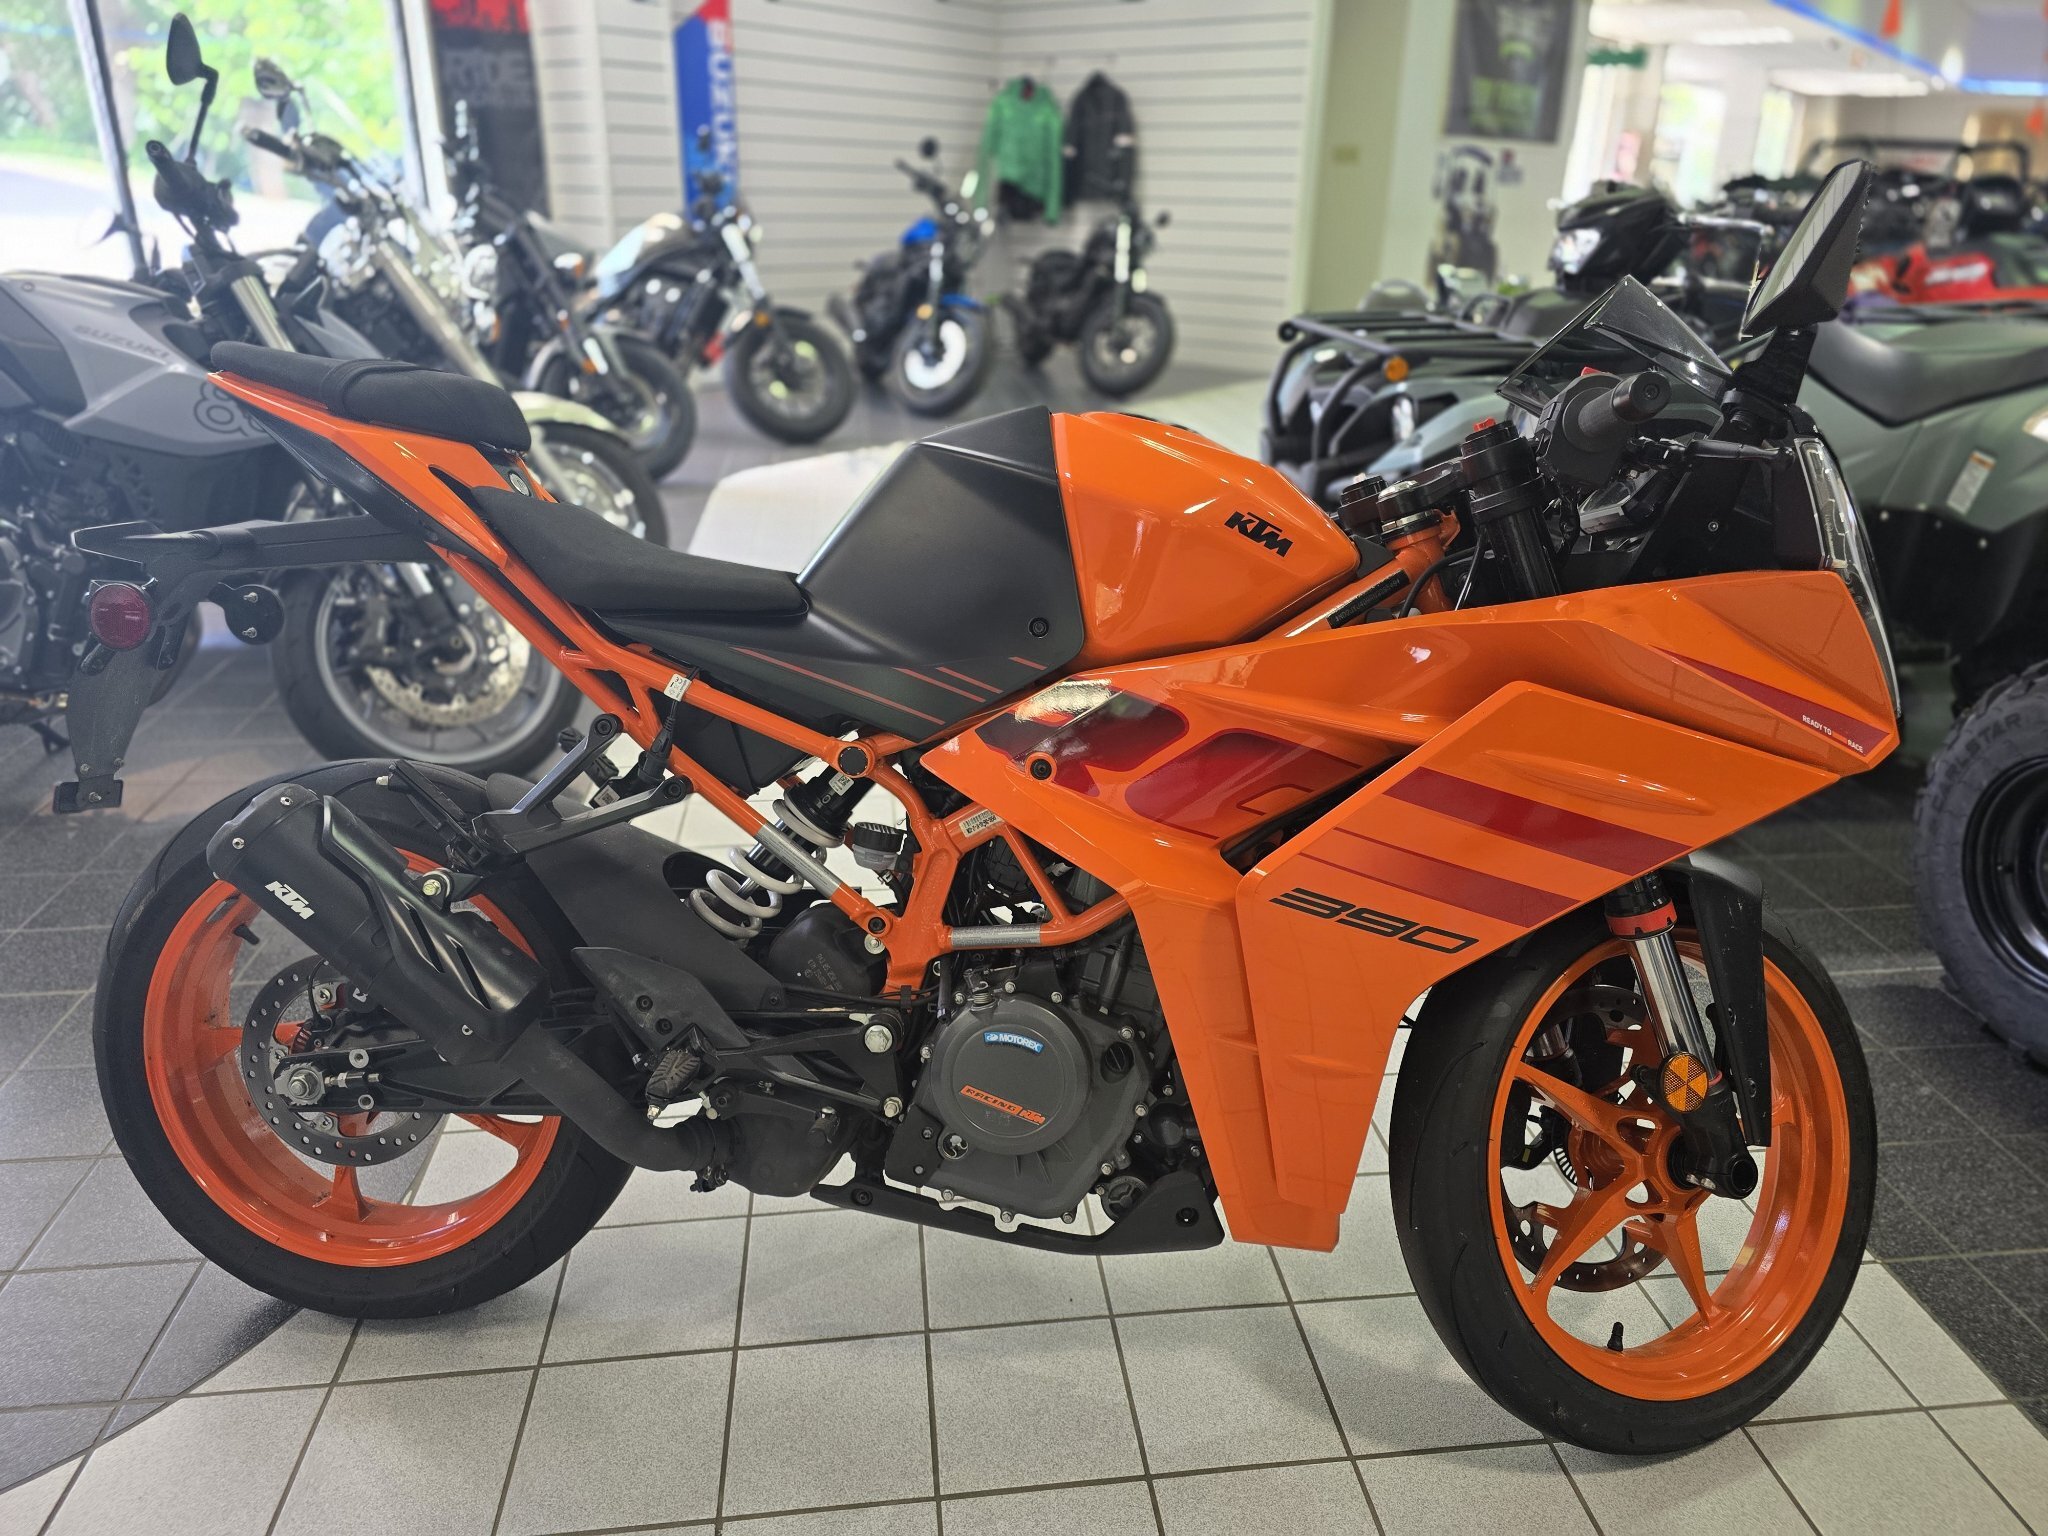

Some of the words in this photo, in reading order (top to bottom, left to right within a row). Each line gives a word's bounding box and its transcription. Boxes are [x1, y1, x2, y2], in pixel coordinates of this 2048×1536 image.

[73, 323, 171, 358] SUZUKI
[1223, 510, 1294, 558] KTM
[1802, 714, 1823, 730] READY
[1823, 726, 1832, 735] TO
[1847, 739, 1863, 753] RACE
[264, 880, 315, 920] KTM
[1268, 887, 1480, 955] 390
[999, 1033, 1040, 1052] MOTOREX
[965, 1087, 1017, 1112] RACING
